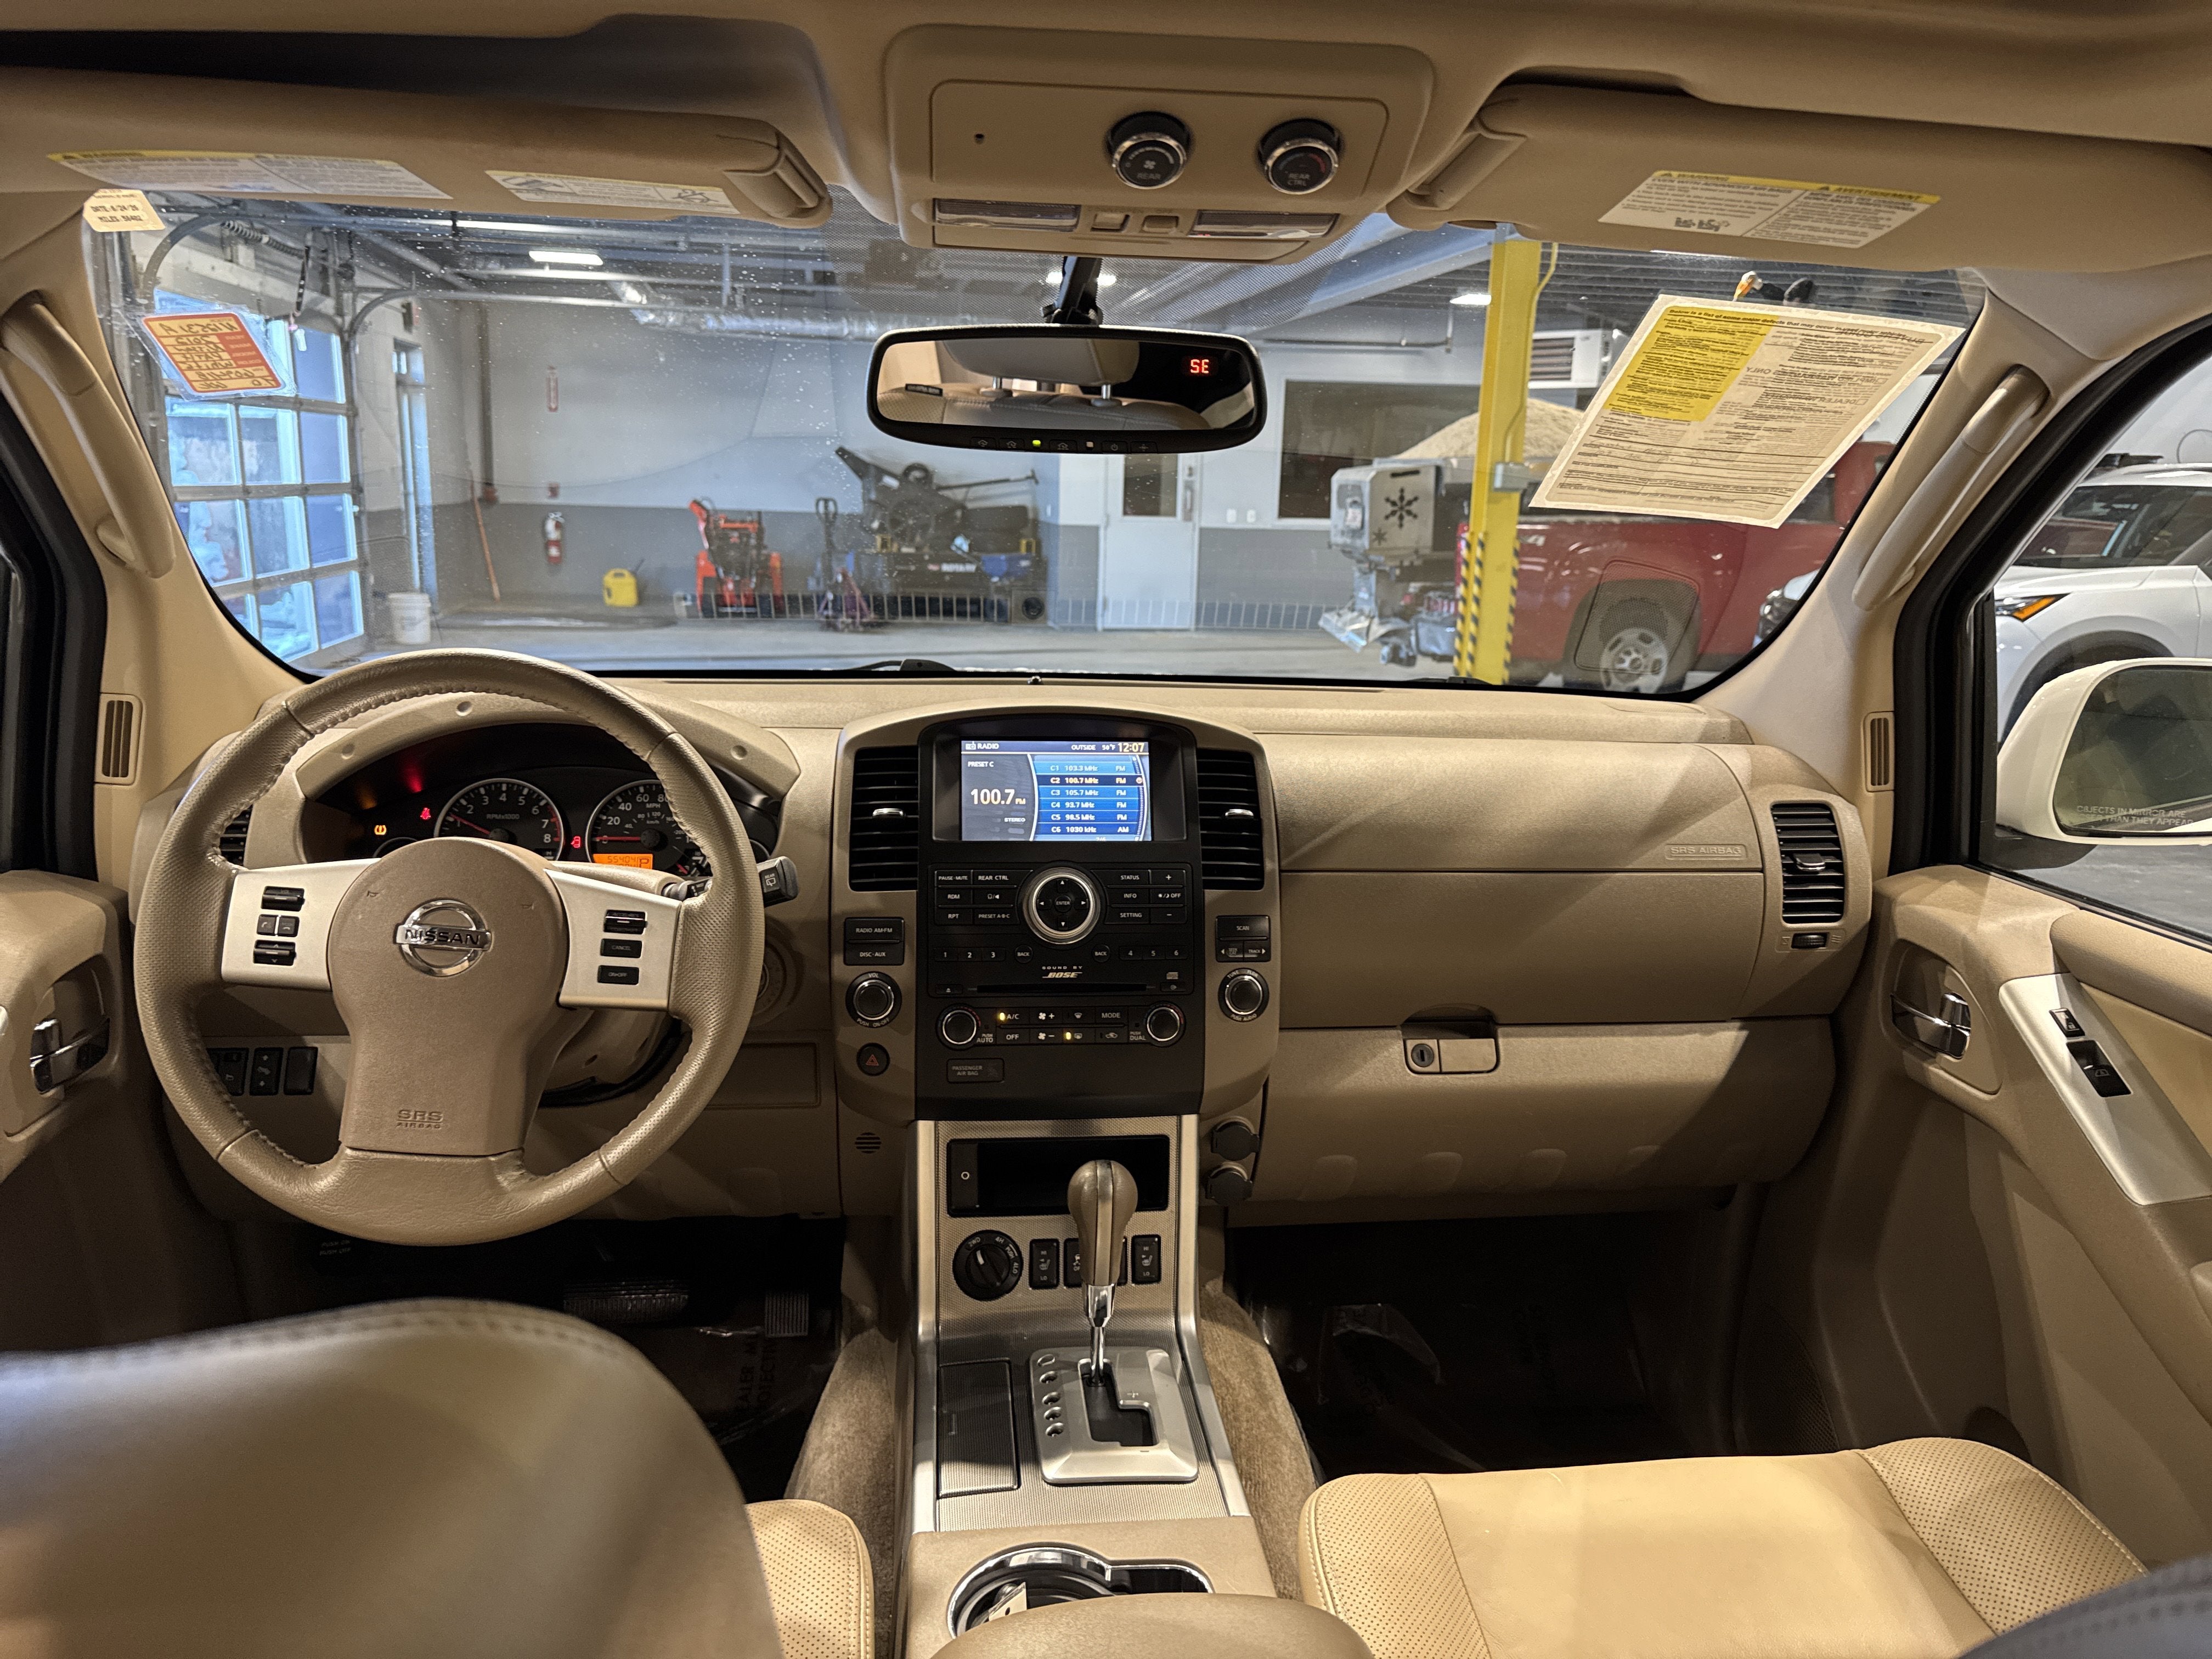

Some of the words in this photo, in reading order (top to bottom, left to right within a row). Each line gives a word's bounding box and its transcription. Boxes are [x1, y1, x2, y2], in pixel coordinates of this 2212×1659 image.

[1190, 359, 1209, 373] SE
[1118, 742, 1145, 752] 12:07
[482, 795, 489, 805] 3
[499, 793, 507, 802] 4
[518, 796, 526, 805] 5
[636, 794, 650, 803] 60
[970, 788, 1015, 805] 100.7
[466, 805, 474, 814] 2
[531, 805, 539, 815] 6
[618, 803, 632, 811] 40
[2076, 805, 2115, 814] OBJECTS
[2129, 808, 2164, 816] MIRROR
[541, 819, 549, 828] 7
[607, 816, 620, 825] 20
[2130, 816, 2155, 825] THEY
[543, 833, 551, 843] 8
[405, 929, 481, 945] NISSAN
[856, 1018, 869, 1026] PUSH
[398, 1109, 443, 1121] SRS
